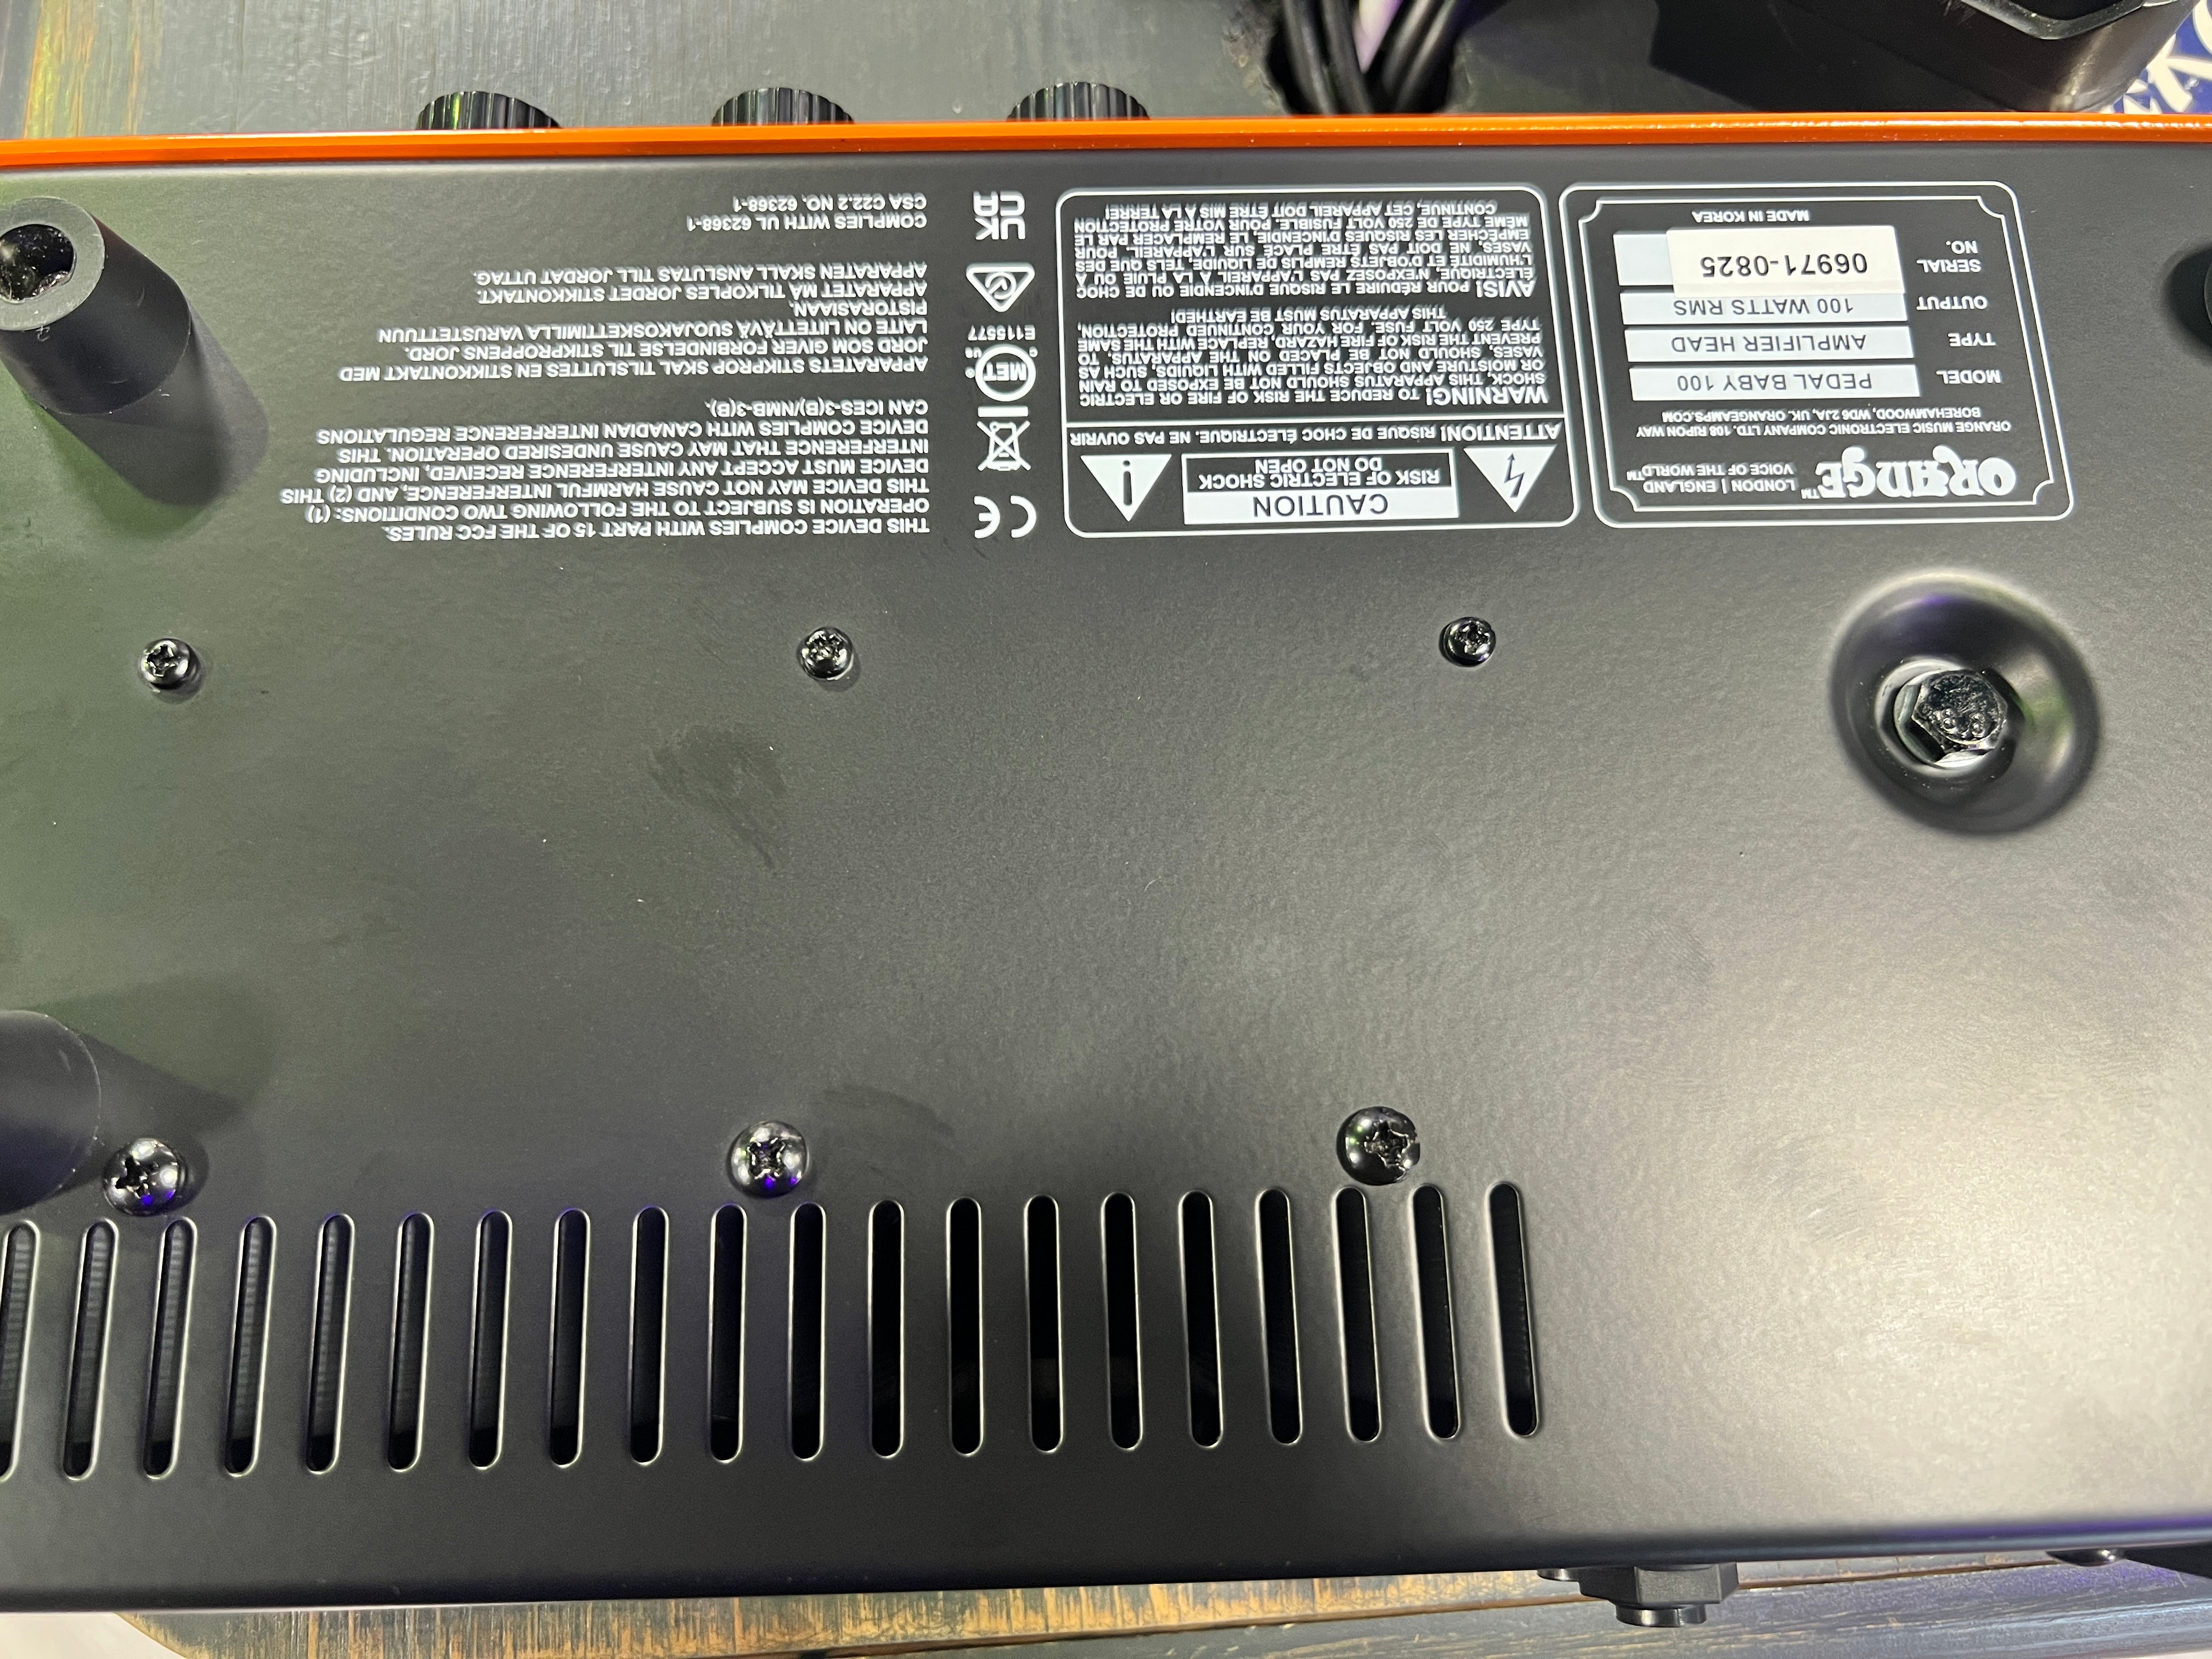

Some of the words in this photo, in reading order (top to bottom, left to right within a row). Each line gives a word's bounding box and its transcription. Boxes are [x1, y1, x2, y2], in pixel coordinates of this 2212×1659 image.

[734, 198, 798, 212] 62368-1
[803, 197, 833, 211] NO.
[839, 196, 885, 211] C22.2
[889, 195, 927, 210] CSA
[756, 216, 780, 230] UL
[785, 215, 831, 230] WITH
[835, 215, 927, 229] COMPLIES
[1692, 211, 1745, 223] KOREA
[1748, 211, 1763, 222] IN
[1767, 210, 1809, 222] MADE
[689, 216, 752, 232] 62368-1
[975, 217, 1025, 240] UK
[1946, 241, 1978, 254] NO.
[757, 266, 816, 280] SKALL
[821, 263, 927, 280] APPARATEN
[1702, 253, 1867, 278] 06971-0825
[1917, 259, 1981, 273] SERIAL
[473, 270, 537, 286] UTTAG.
[540, 269, 613, 284] JORDAT
[617, 268, 654, 283] TILL
[659, 267, 754, 282] ANSLUTAS
[1077, 286, 1120, 299] CHOC
[1126, 286, 1146, 298] DE
[1153, 286, 1175, 297] OU
[1180, 284, 1264, 297] D'INCENDIE
[1269, 283, 1326, 295] RISQUE
[1331, 283, 1351, 295] LE
[1356, 282, 1422, 294] RÉDUIRE
[1427, 281, 1470, 293] POUR
[1476, 280, 1535, 298] AVIS!
[790, 301, 927, 317] PISTORASIAAN.
[1674, 300, 1723, 316] RMS
[1731, 299, 1810, 315] WATTS
[1818, 298, 1853, 314] 100
[1917, 296, 1988, 310] OUTPUT
[1171, 311, 1246, 324] EARTHED!
[1250, 311, 1271, 323] BE
[1274, 309, 1316, 321] MUST
[1320, 308, 1409, 321] APPARATUS
[1412, 307, 1446, 319] THIS
[379, 326, 524, 343] VARUSTETTUUN
[527, 322, 733, 340] SUOJAKOSKETTIMILLA
[737, 320, 840, 339] LIITETTÄVÄ
[845, 320, 872, 335] ON
[877, 319, 927, 335] LAITE
[968, 326, 1035, 340] E115577
[1672, 337, 1735, 352] HEAD
[1743, 335, 1866, 352] AMPLIFIER
[1948, 333, 1996, 347] TYPE
[384, 364, 513, 381] STIKKONTAKT
[517, 363, 542, 378] EN
[547, 362, 656, 377] TILSLUTTES
[660, 360, 709, 376] SKAL
[713, 359, 805, 375] STIKPROP
[809, 357, 928, 374] APPARATETS
[983, 362, 1026, 381] MET
[340, 366, 380, 381] MED
[1449, 374, 1483, 386] THIS
[1488, 373, 1545, 385] SHOCK,
[1937, 370, 2001, 384] MODEL
[1080, 380, 1116, 393] RAIN
[1121, 380, 1142, 392] TO
[1147, 378, 1219, 392] EXPOSED
[1224, 378, 1245, 390] BE
[1250, 377, 1282, 390] NOT
[1287, 376, 1350, 388] SHOULD
[1355, 375, 1445, 388] APPARATUS
[1678, 376, 1714, 392] 100
[1724, 374, 1786, 391] BABY
[1794, 374, 1872, 390] PEDAL
[1080, 393, 1154, 407] ELECTRIC
[1159, 393, 1182, 405] OR
[1188, 392, 1222, 405] FIRE
[1228, 392, 1248, 404] OF
[1254, 391, 1289, 403] RISK
[1295, 391, 1325, 402] THE
[1330, 389, 1393, 402] REDUCE
[1398, 388, 1419, 400] TO
[1426, 386, 1548, 405] WARNING!
[707, 399, 884, 417] ICES-3(B)/NMB-3(B).
[889, 400, 928, 415] CAN
[1813, 409, 1840, 421] 2JA,
[1842, 409, 1871, 420] WD6
[1873, 407, 1981, 420] BOREHAMWOOD,
[1663, 410, 1786, 422] ORANGEAMPS.COM
[1788, 411, 1810, 421] UK.
[1351, 428, 1372, 440] DE
[1377, 427, 1435, 440] RISQUE
[1441, 424, 1560, 442] ATTENTION!
[1637, 427, 1665, 437] WAY
[1667, 426, 1707, 437] RIPON
[1709, 426, 1731, 437] 108
[1734, 425, 1761, 437] LTD.
[1764, 425, 1826, 436] COMPANY
[1829, 423, 1910, 435] ELECTRONIC
[1913, 422, 1954, 433] MUSIC
[1956, 421, 2011, 433] ORANGE
[1070, 432, 1130, 447] OUVRIR
[1134, 432, 1165, 445] PAS
[1169, 432, 1190, 444] NE
[1195, 430, 1297, 444] ÉLECTRIQUE.
[1302, 428, 1346, 442] CHOC
[1255, 459, 1307, 474] OPEN
[1311, 458, 1350, 473] NOT
[1355, 458, 1382, 472] DO
[1697, 465, 1725, 476] THE
[1729, 465, 1748, 476] OF
[1750, 464, 1794, 476] VOICE
[1199, 474, 1265, 489] SHOCK
[1271, 472, 1361, 488] ELECTRIC
[1366, 471, 1391, 486] OF
[1396, 470, 1440, 485] RISK
[403, 484, 552, 501] INTERFERENCE,
[557, 482, 649, 499] HARMFUL
[654, 481, 719, 497] CAUSE
[724, 481, 764, 496] NOT
[768, 480, 808, 495] MAY
[813, 478, 882, 494] DEVICE
[887, 478, 930, 494] THIS
[1644, 480, 1717, 493] ENGLAND
[1731, 479, 1796, 492] LONDON
[281, 488, 325, 504] THIS
[330, 484, 352, 503] (2)
[358, 487, 399, 503] AND
[462, 505, 508, 520] TWO
[513, 503, 627, 519] FOLLOWING
[632, 502, 670, 517] THE
[674, 501, 701, 516] TO
[705, 500, 793, 516] SUBJECT
[798, 500, 815, 515] IS
[821, 498, 930, 515] OPERATION
[1254, 494, 1388, 517] CAUTION
[308, 505, 331, 523] (1)
[336, 505, 459, 522] CONDITIONS:
[383, 526, 453, 541] RULES.
[457, 524, 496, 540] FCC
[501, 524, 540, 539] THE
[543, 523, 571, 538] OF
[574, 523, 596, 538] 15
[600, 522, 652, 537] PART
[657, 521, 706, 537] WITH
[710, 520, 808, 536] COMPLIES
[812, 518, 882, 534] DEVICE
[887, 518, 930, 534] THIS
